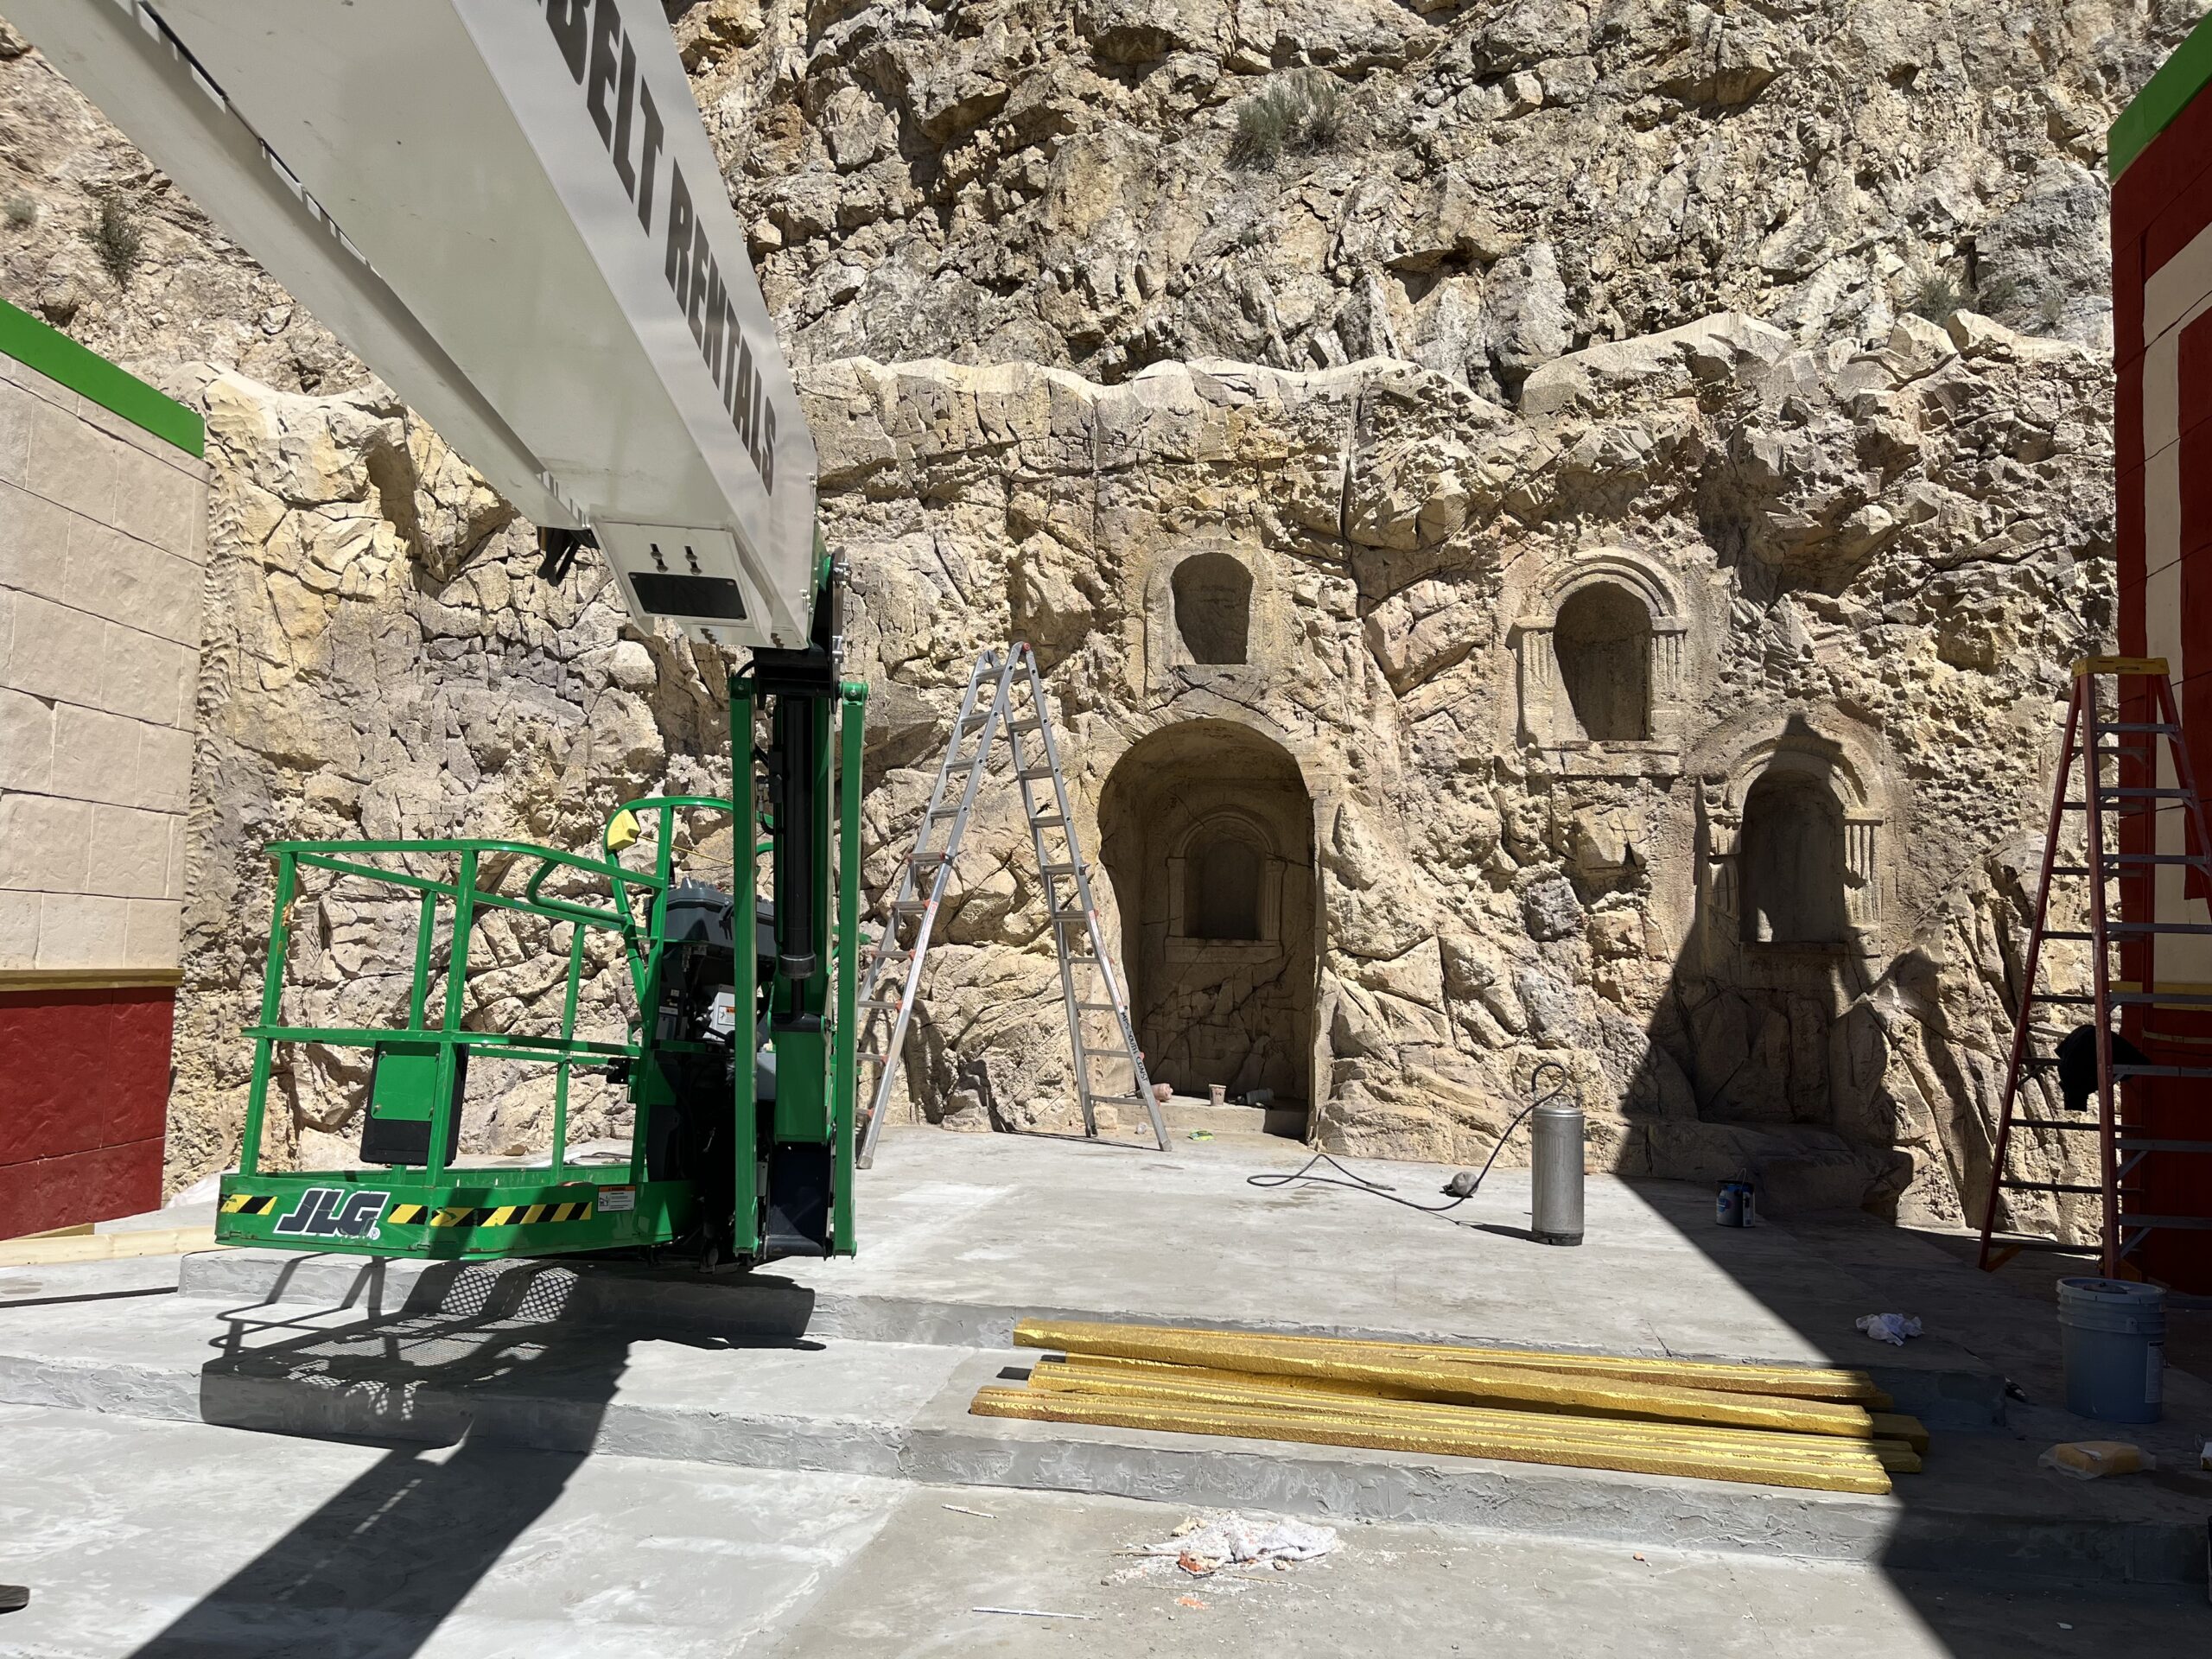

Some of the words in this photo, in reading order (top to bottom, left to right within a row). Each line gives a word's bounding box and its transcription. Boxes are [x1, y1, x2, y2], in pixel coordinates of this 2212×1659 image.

[664, 157, 776, 496] RENTALS
[1128, 1031, 1138, 1054] SOUTH
[1136, 1056, 1148, 1081] CONST
[273, 1187, 391, 1238] JLG
